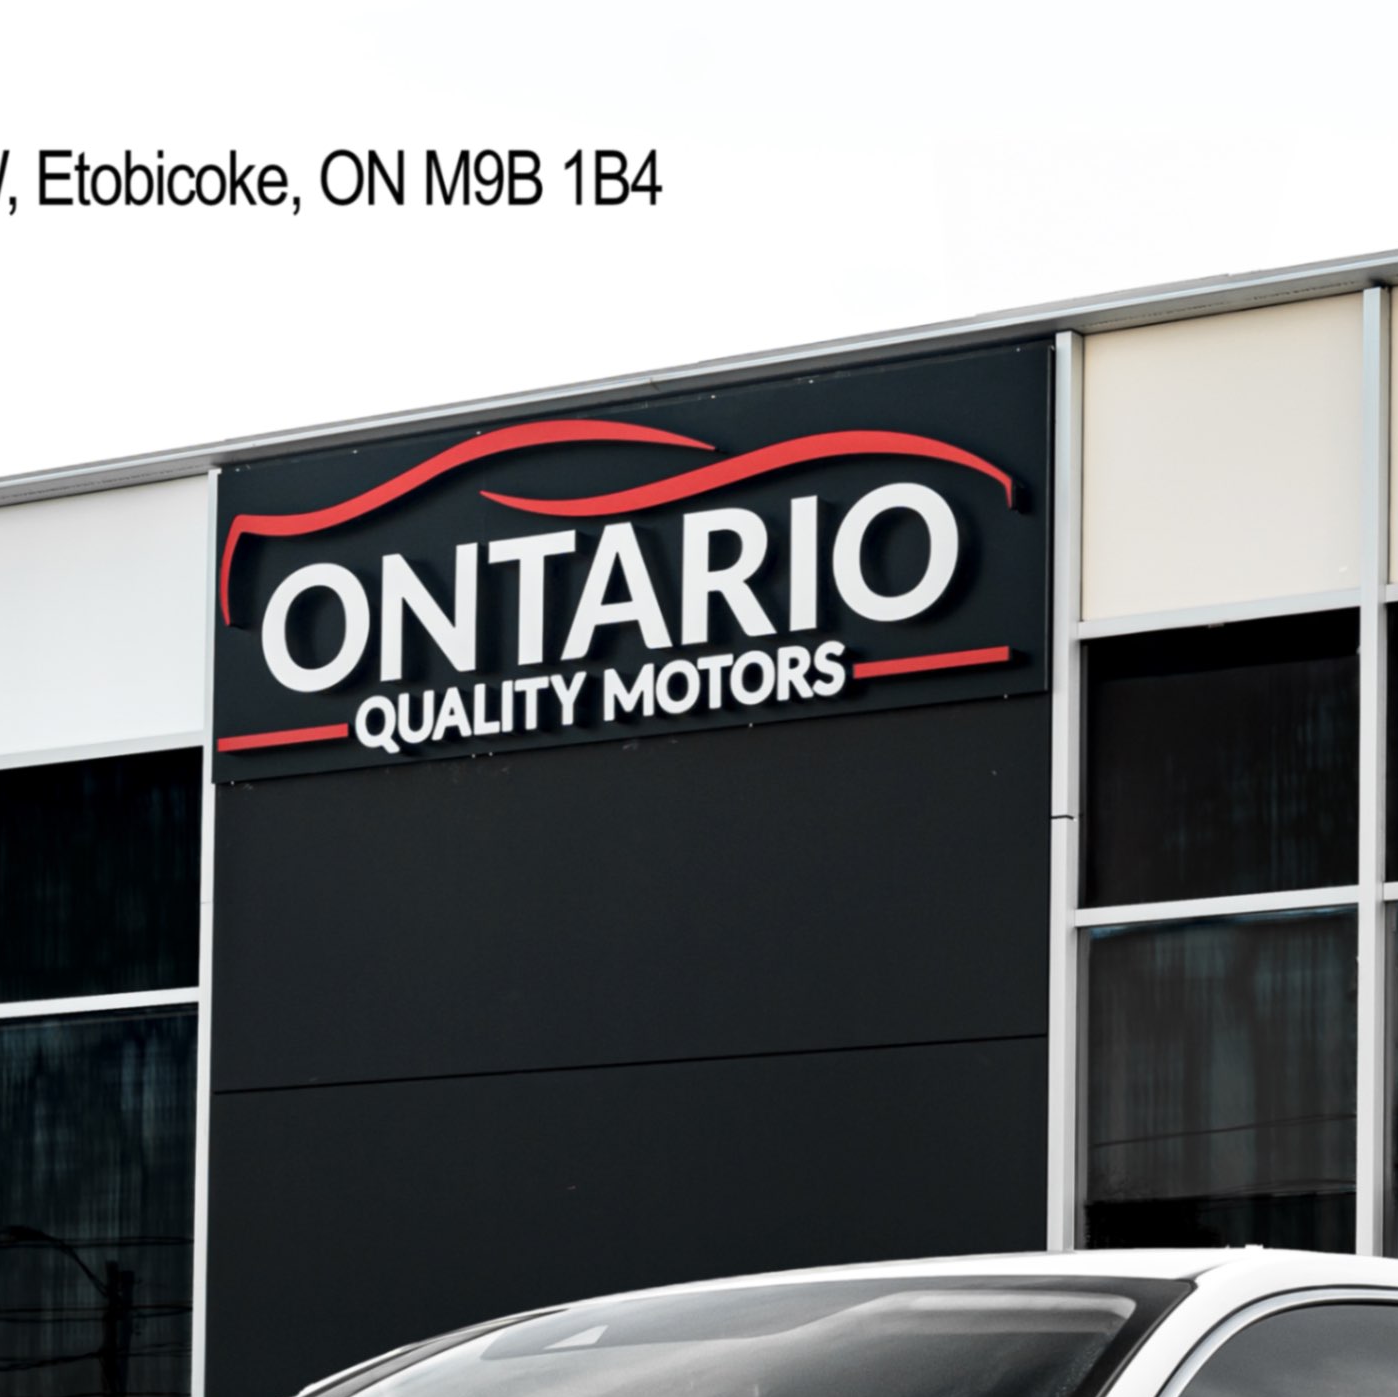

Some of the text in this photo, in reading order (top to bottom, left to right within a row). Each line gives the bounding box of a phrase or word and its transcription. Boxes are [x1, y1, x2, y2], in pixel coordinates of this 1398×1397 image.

[262, 483, 958, 692] ONTARIO
[356, 641, 845, 753] QUALITY MOTORS
